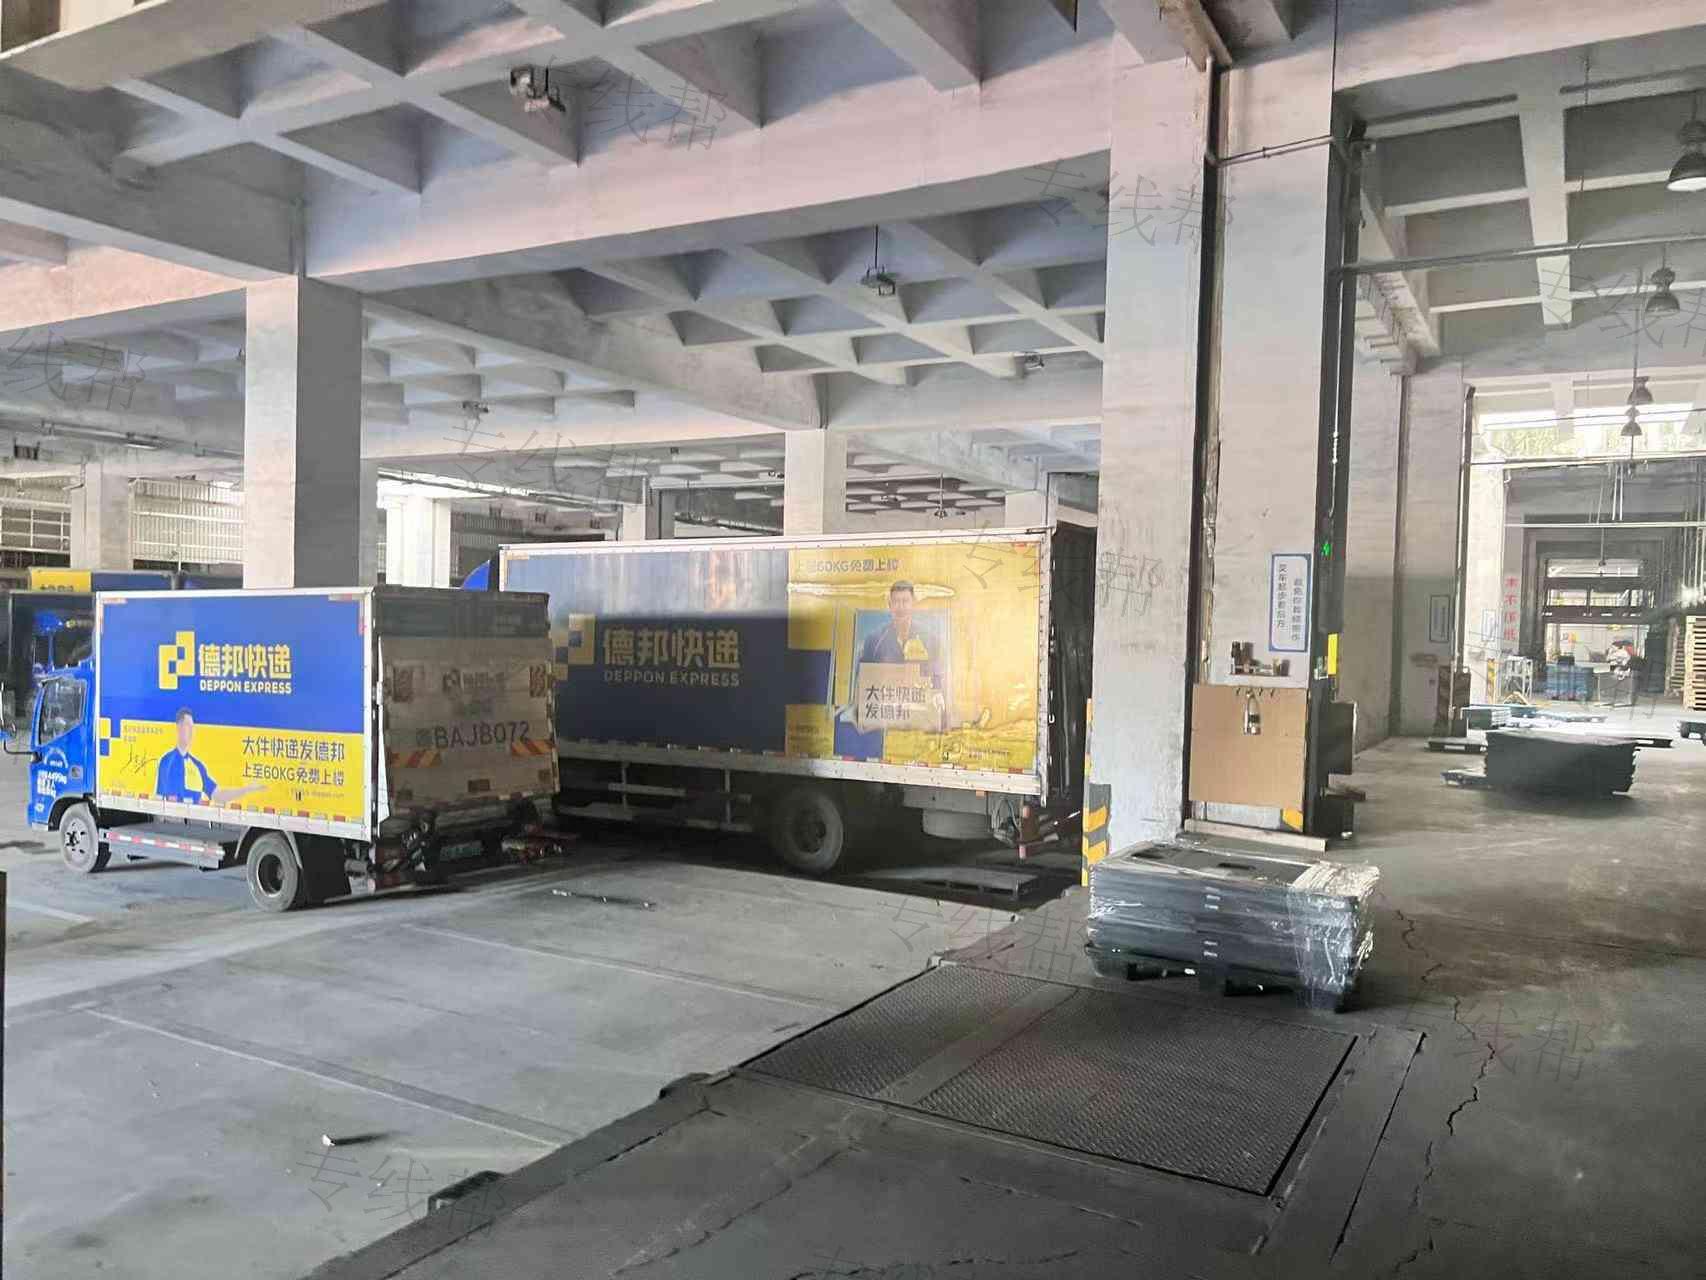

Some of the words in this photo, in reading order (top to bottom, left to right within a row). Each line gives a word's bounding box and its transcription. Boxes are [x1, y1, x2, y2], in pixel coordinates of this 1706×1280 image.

[198, 643, 292, 679] 德邦快递
[604, 629, 741, 668] 德邦快递
[199, 679, 241, 692] DEPPON
[244, 681, 292, 694] EXPRESS
[604, 670, 666, 684] DEPPON
[669, 671, 740, 687] EXPRESS
[241, 735, 345, 762] 大件快递发德邦
[241, 761, 345, 786] 上至60KG免费上楼
